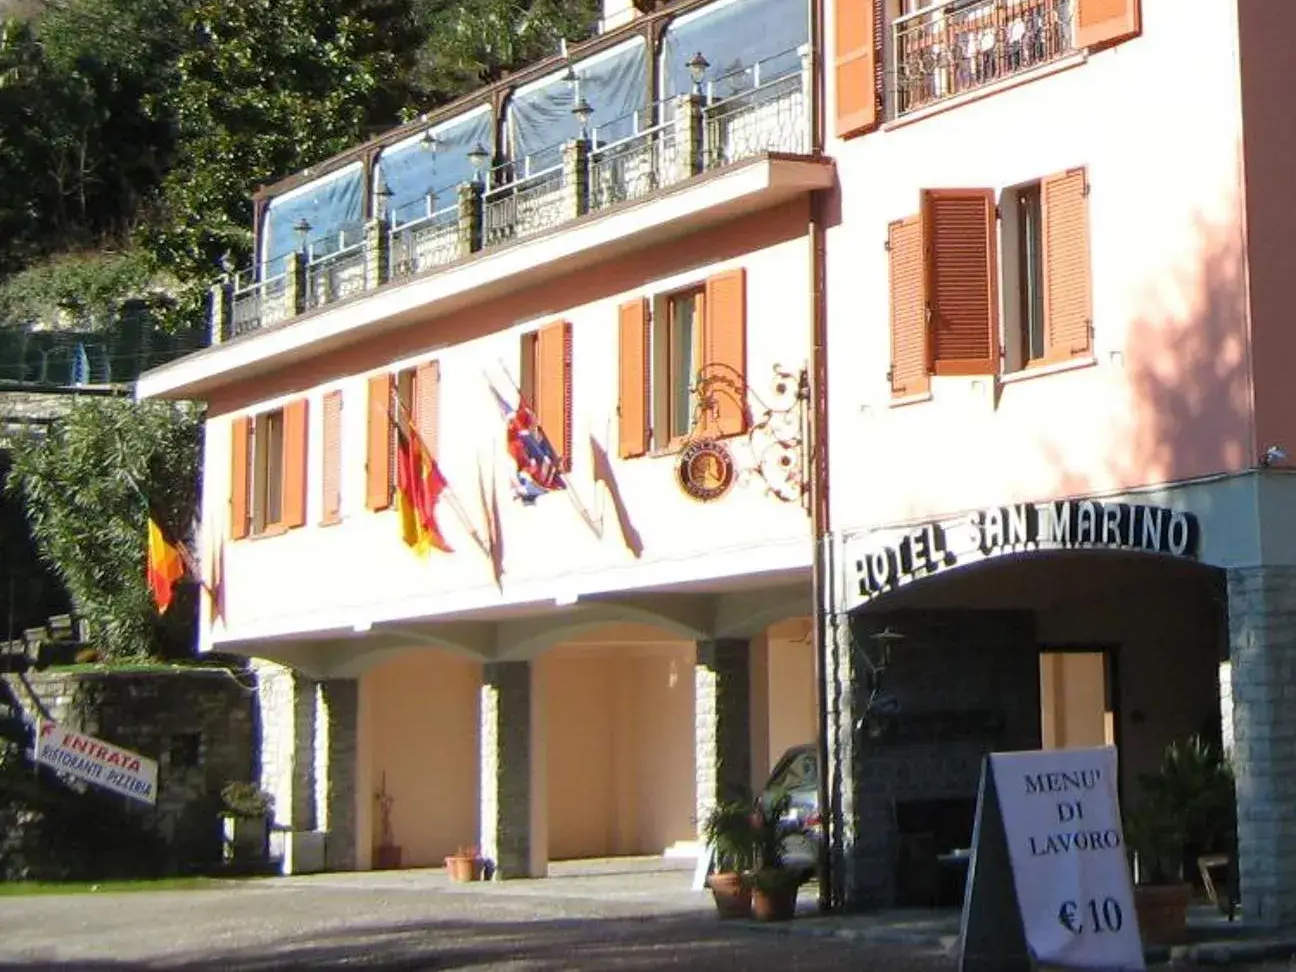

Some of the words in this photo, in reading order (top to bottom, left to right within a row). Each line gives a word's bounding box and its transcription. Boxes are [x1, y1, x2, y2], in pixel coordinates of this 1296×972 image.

[852, 524, 945, 595] HOTEL
[968, 503, 1030, 554] SAN
[1047, 501, 1191, 558] MARINO
[62, 734, 142, 773] ENTRATA
[1024, 769, 1101, 795] MENU'
[1057, 801, 1084, 824] DI
[1029, 829, 1121, 858] LAVORO
